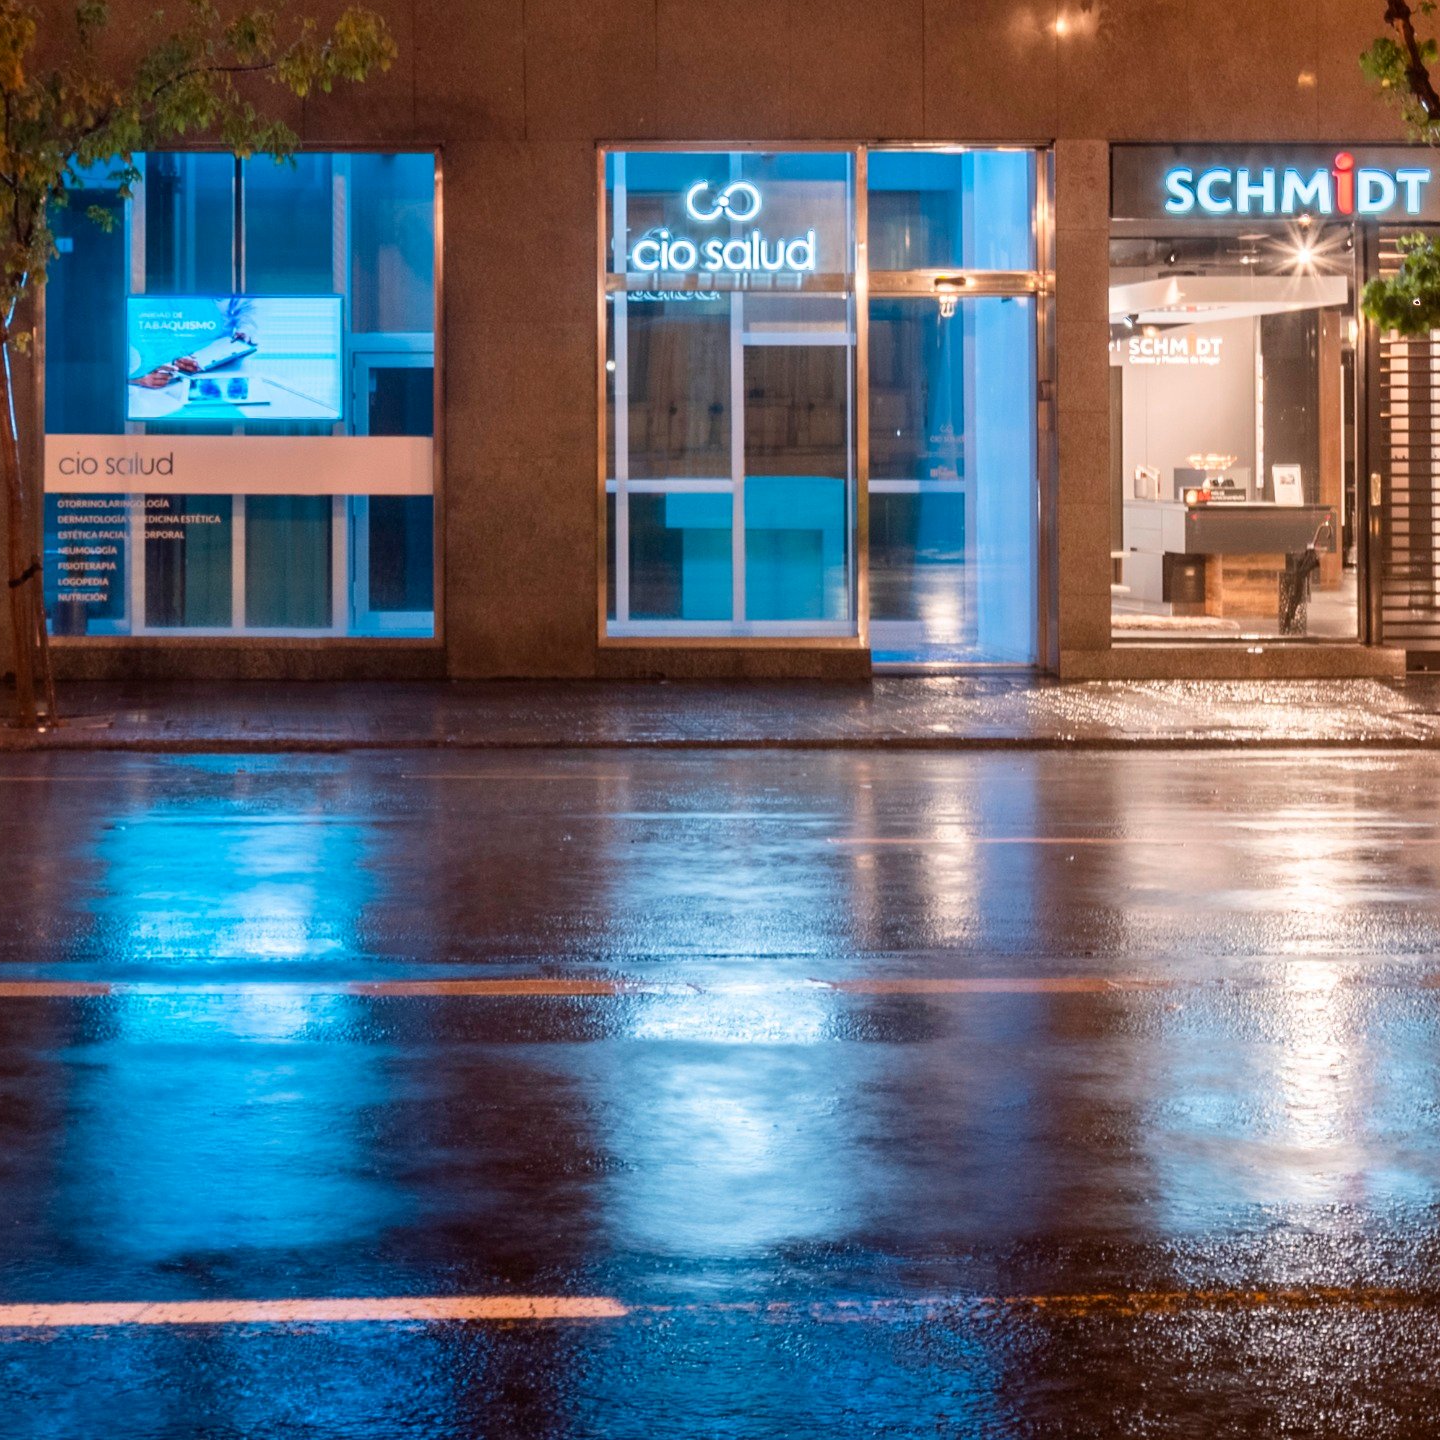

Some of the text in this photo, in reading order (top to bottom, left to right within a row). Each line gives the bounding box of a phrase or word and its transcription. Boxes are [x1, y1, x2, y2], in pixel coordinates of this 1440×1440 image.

[632, 228, 816, 271] cio salud
[139, 320, 216, 331] TABAQUISMO
[58, 451, 174, 475] cio salud
[57, 513, 127, 525] DERMATOLOGÍA
[181, 512, 222, 524] ESTÉTICA
[57, 528, 98, 539] ESTÉTICA
[99, 530, 128, 539] FACIAL
[137, 530, 185, 539] ORPORAL
[58, 544, 117, 555] NEUMOLOGÍA
[58, 561, 117, 570] FISIOTERAPIA
[58, 577, 109, 586] LOGOPEDIA
[58, 592, 108, 602] NUTRICIÓN
